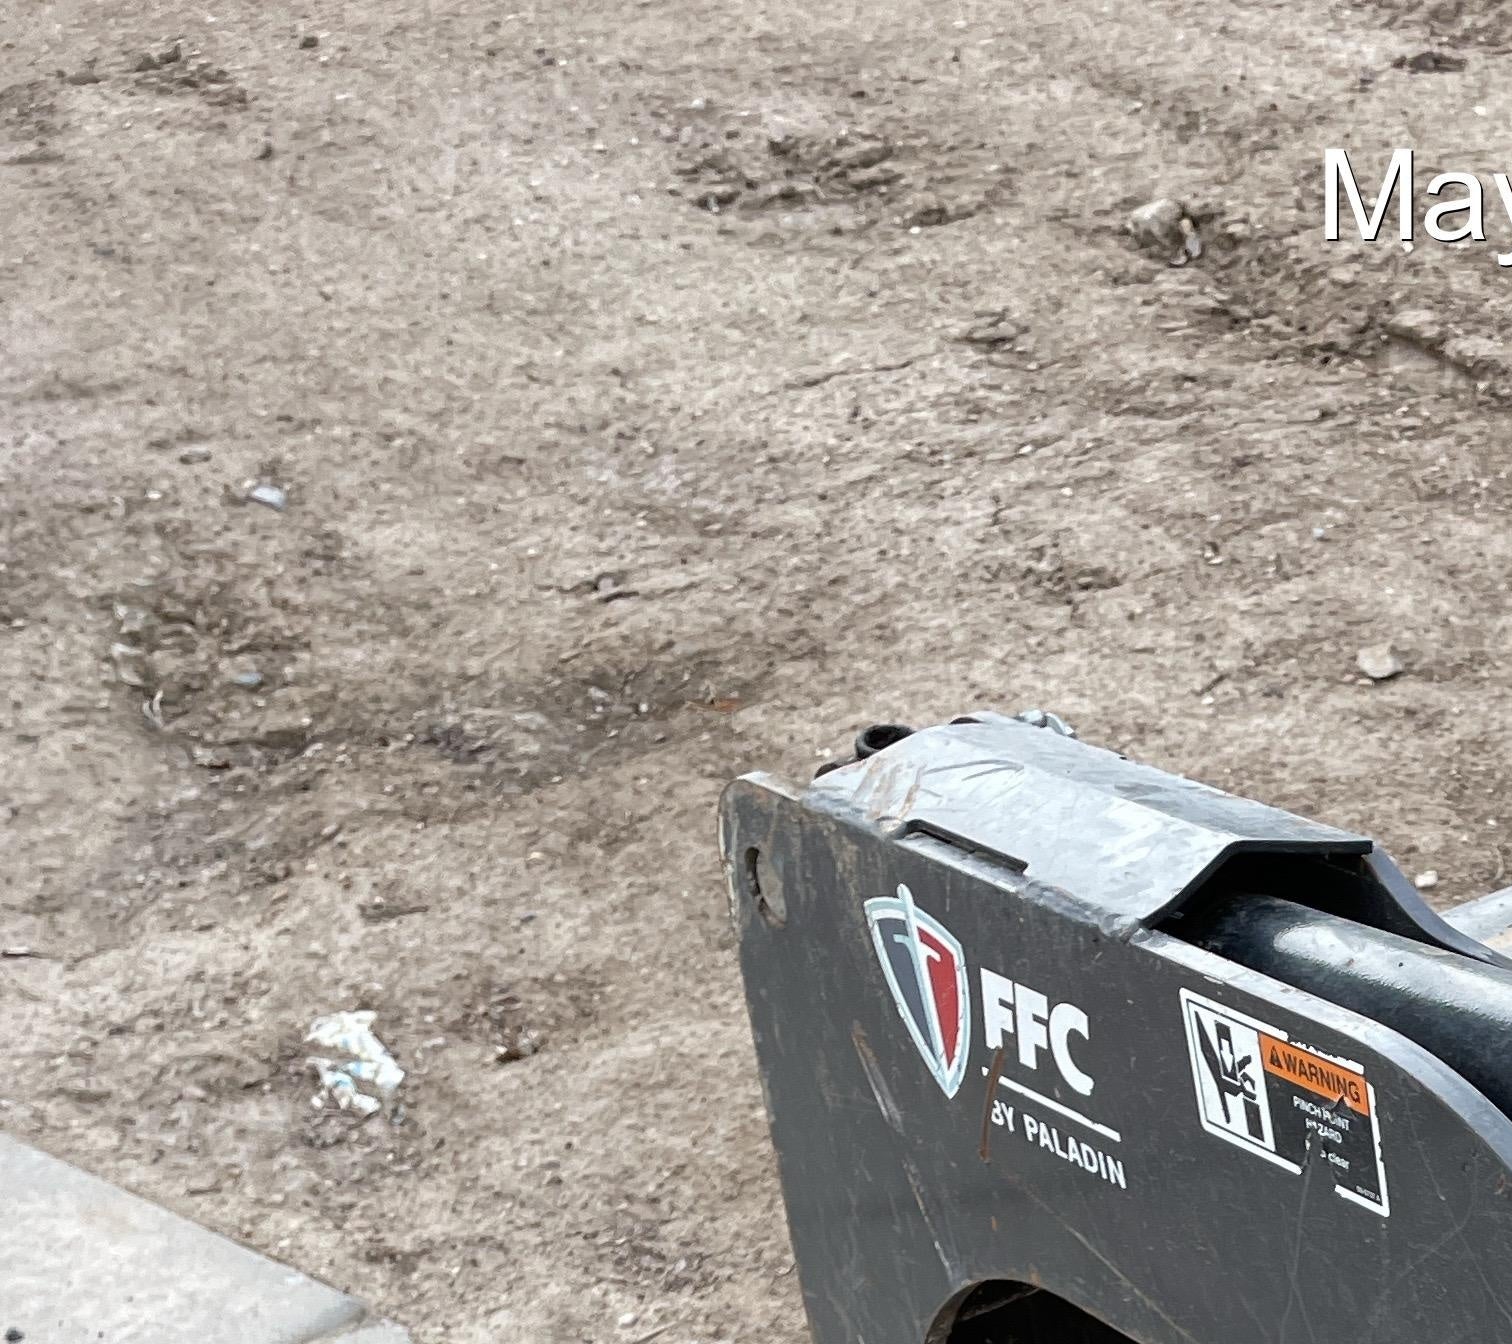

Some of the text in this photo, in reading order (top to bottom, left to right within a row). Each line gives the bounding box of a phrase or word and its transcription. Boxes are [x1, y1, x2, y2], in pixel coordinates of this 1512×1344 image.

[980, 967, 1095, 1096] FFC
[1282, 1050, 1361, 1104] WARNING
[991, 1100, 1127, 1190] BY PALADIN
